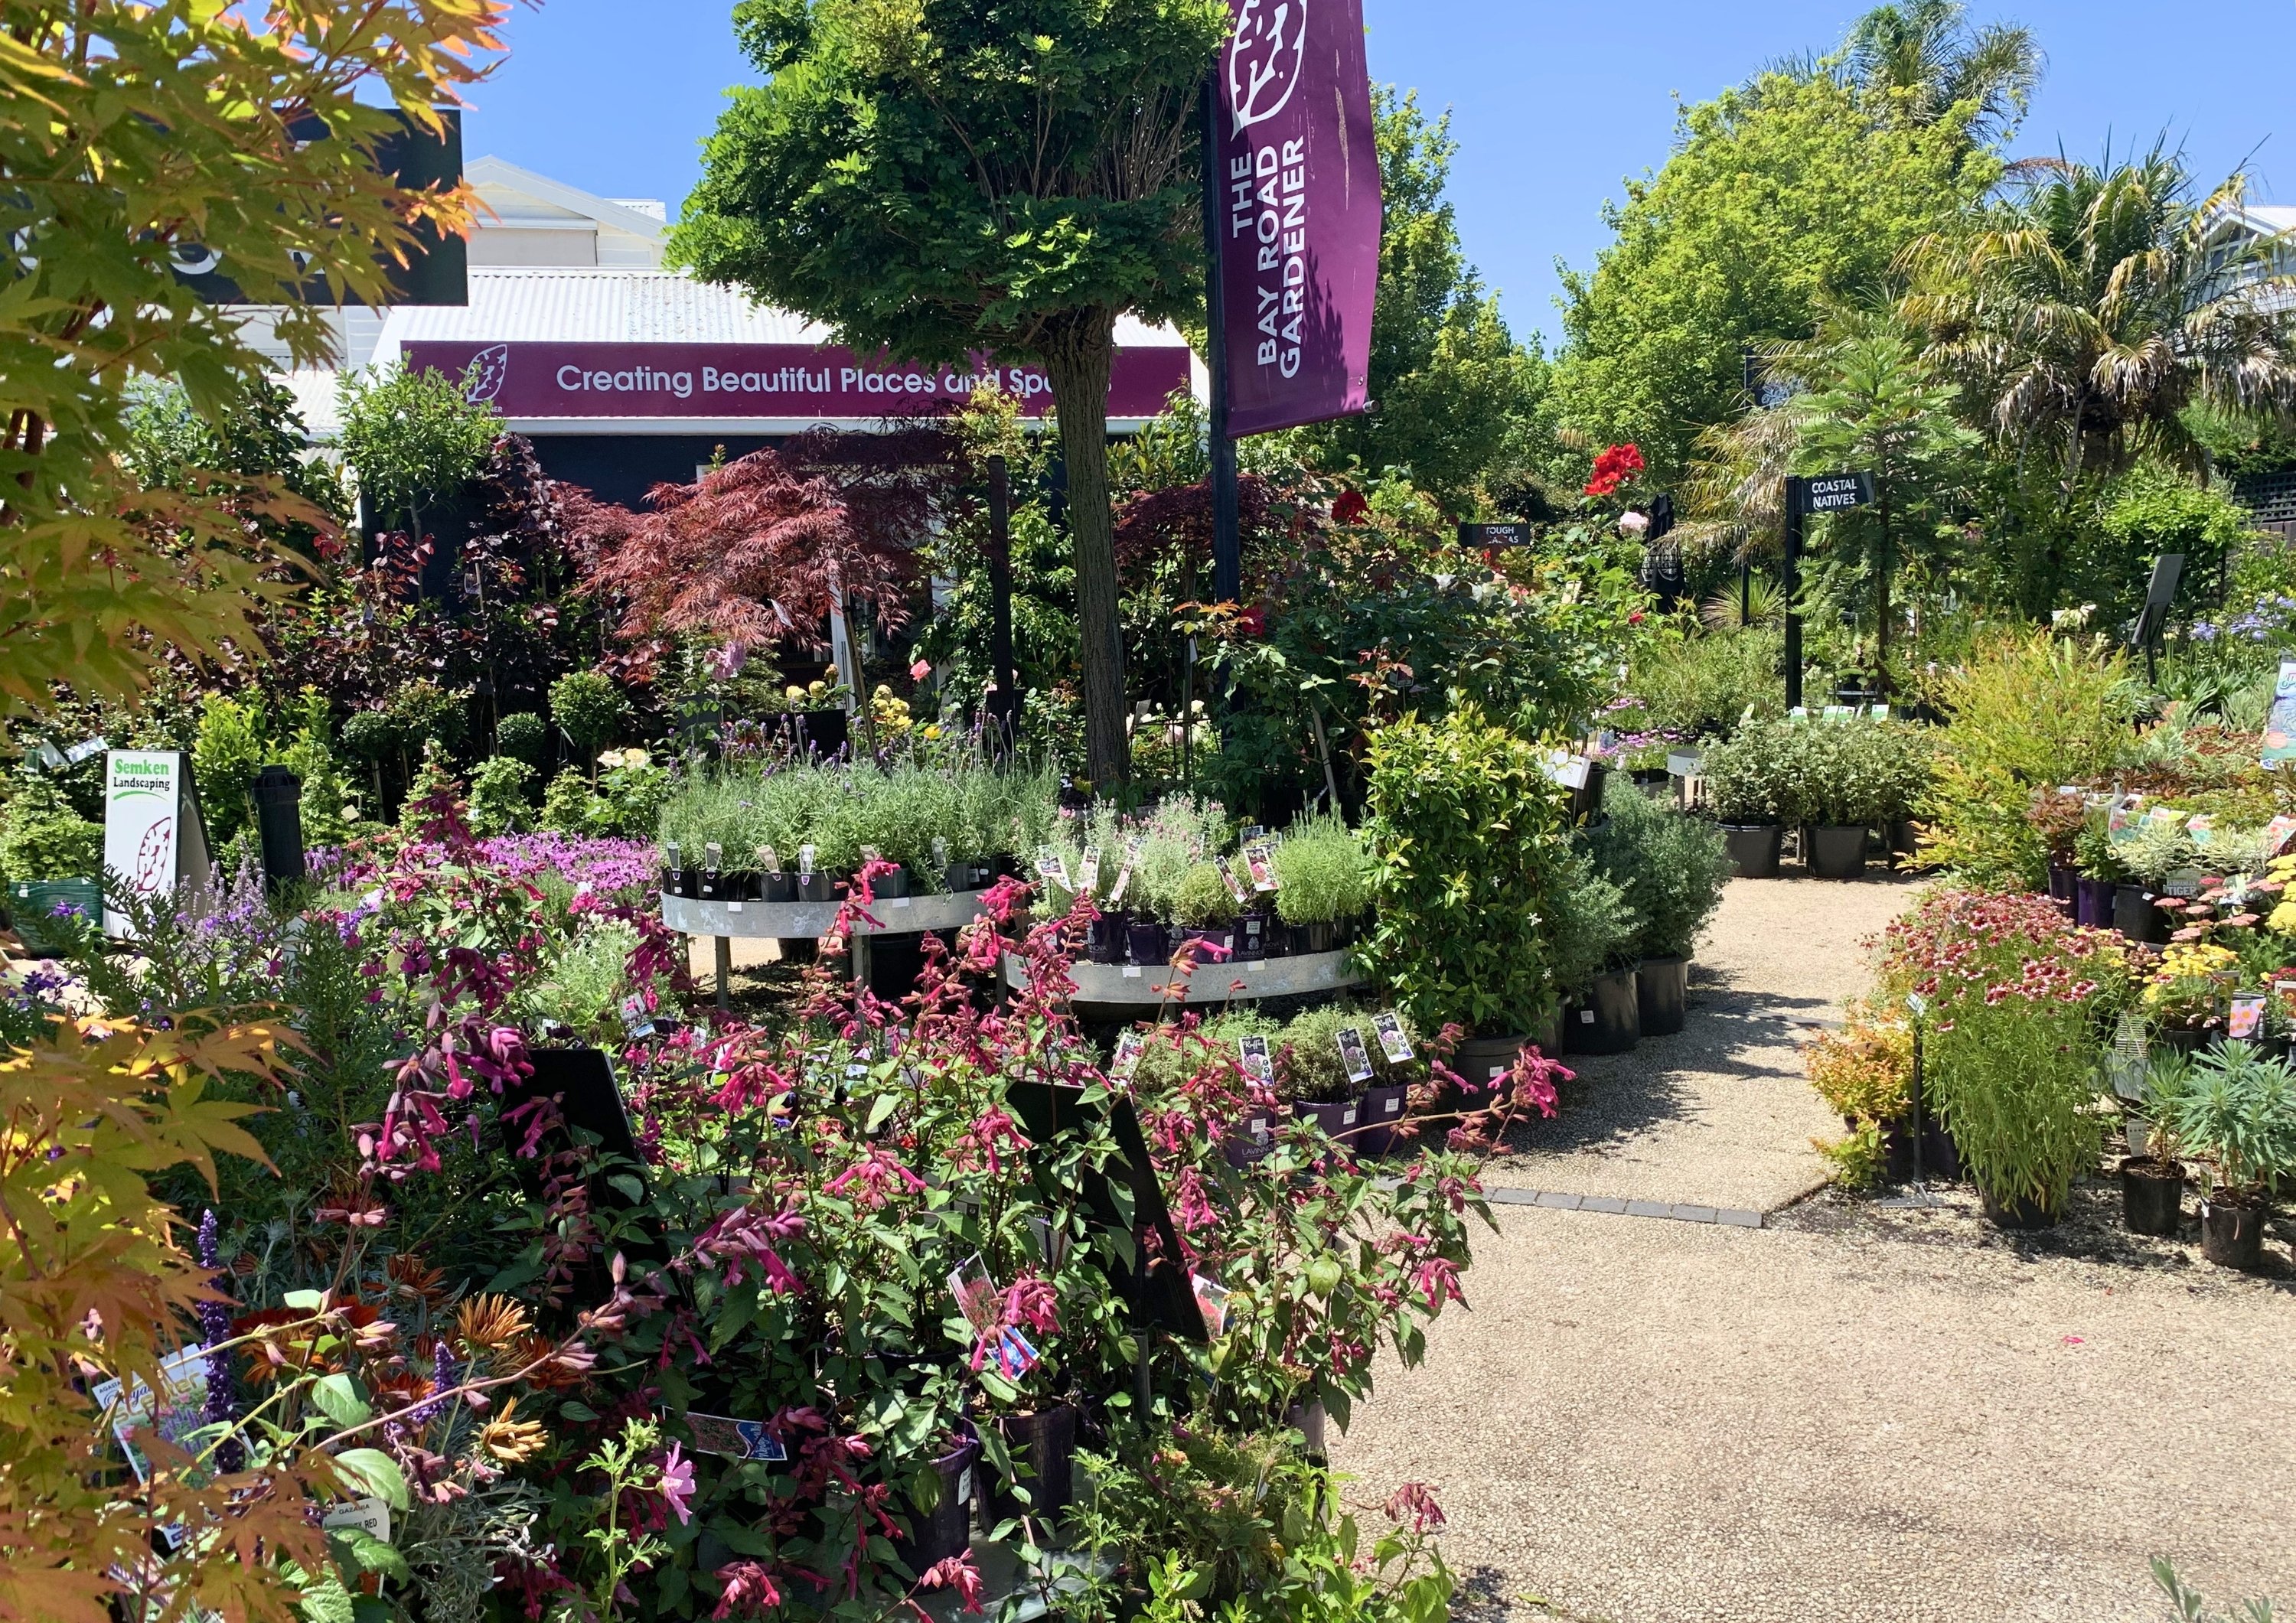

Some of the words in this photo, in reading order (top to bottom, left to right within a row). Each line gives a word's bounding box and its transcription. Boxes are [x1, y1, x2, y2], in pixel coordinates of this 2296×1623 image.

[1231, 152, 1253, 238] THE
[1255, 145, 1280, 272] ROAD
[1280, 135, 1305, 379] GARDENER
[1257, 286, 1280, 366] BAY
[556, 365, 693, 398] Creating
[703, 367, 830, 393] Beautiful
[842, 369, 936, 393] Places
[1812, 478, 1857, 494] COASTAL
[1813, 493, 1855, 507] NATIVES
[115, 758, 169, 775] Semken
[113, 777, 170, 791] Landscaping
[2167, 886, 2197, 895] TIGER
[99, 1380, 122, 1393] AGASTA
[364, 1518, 377, 1529] RED
